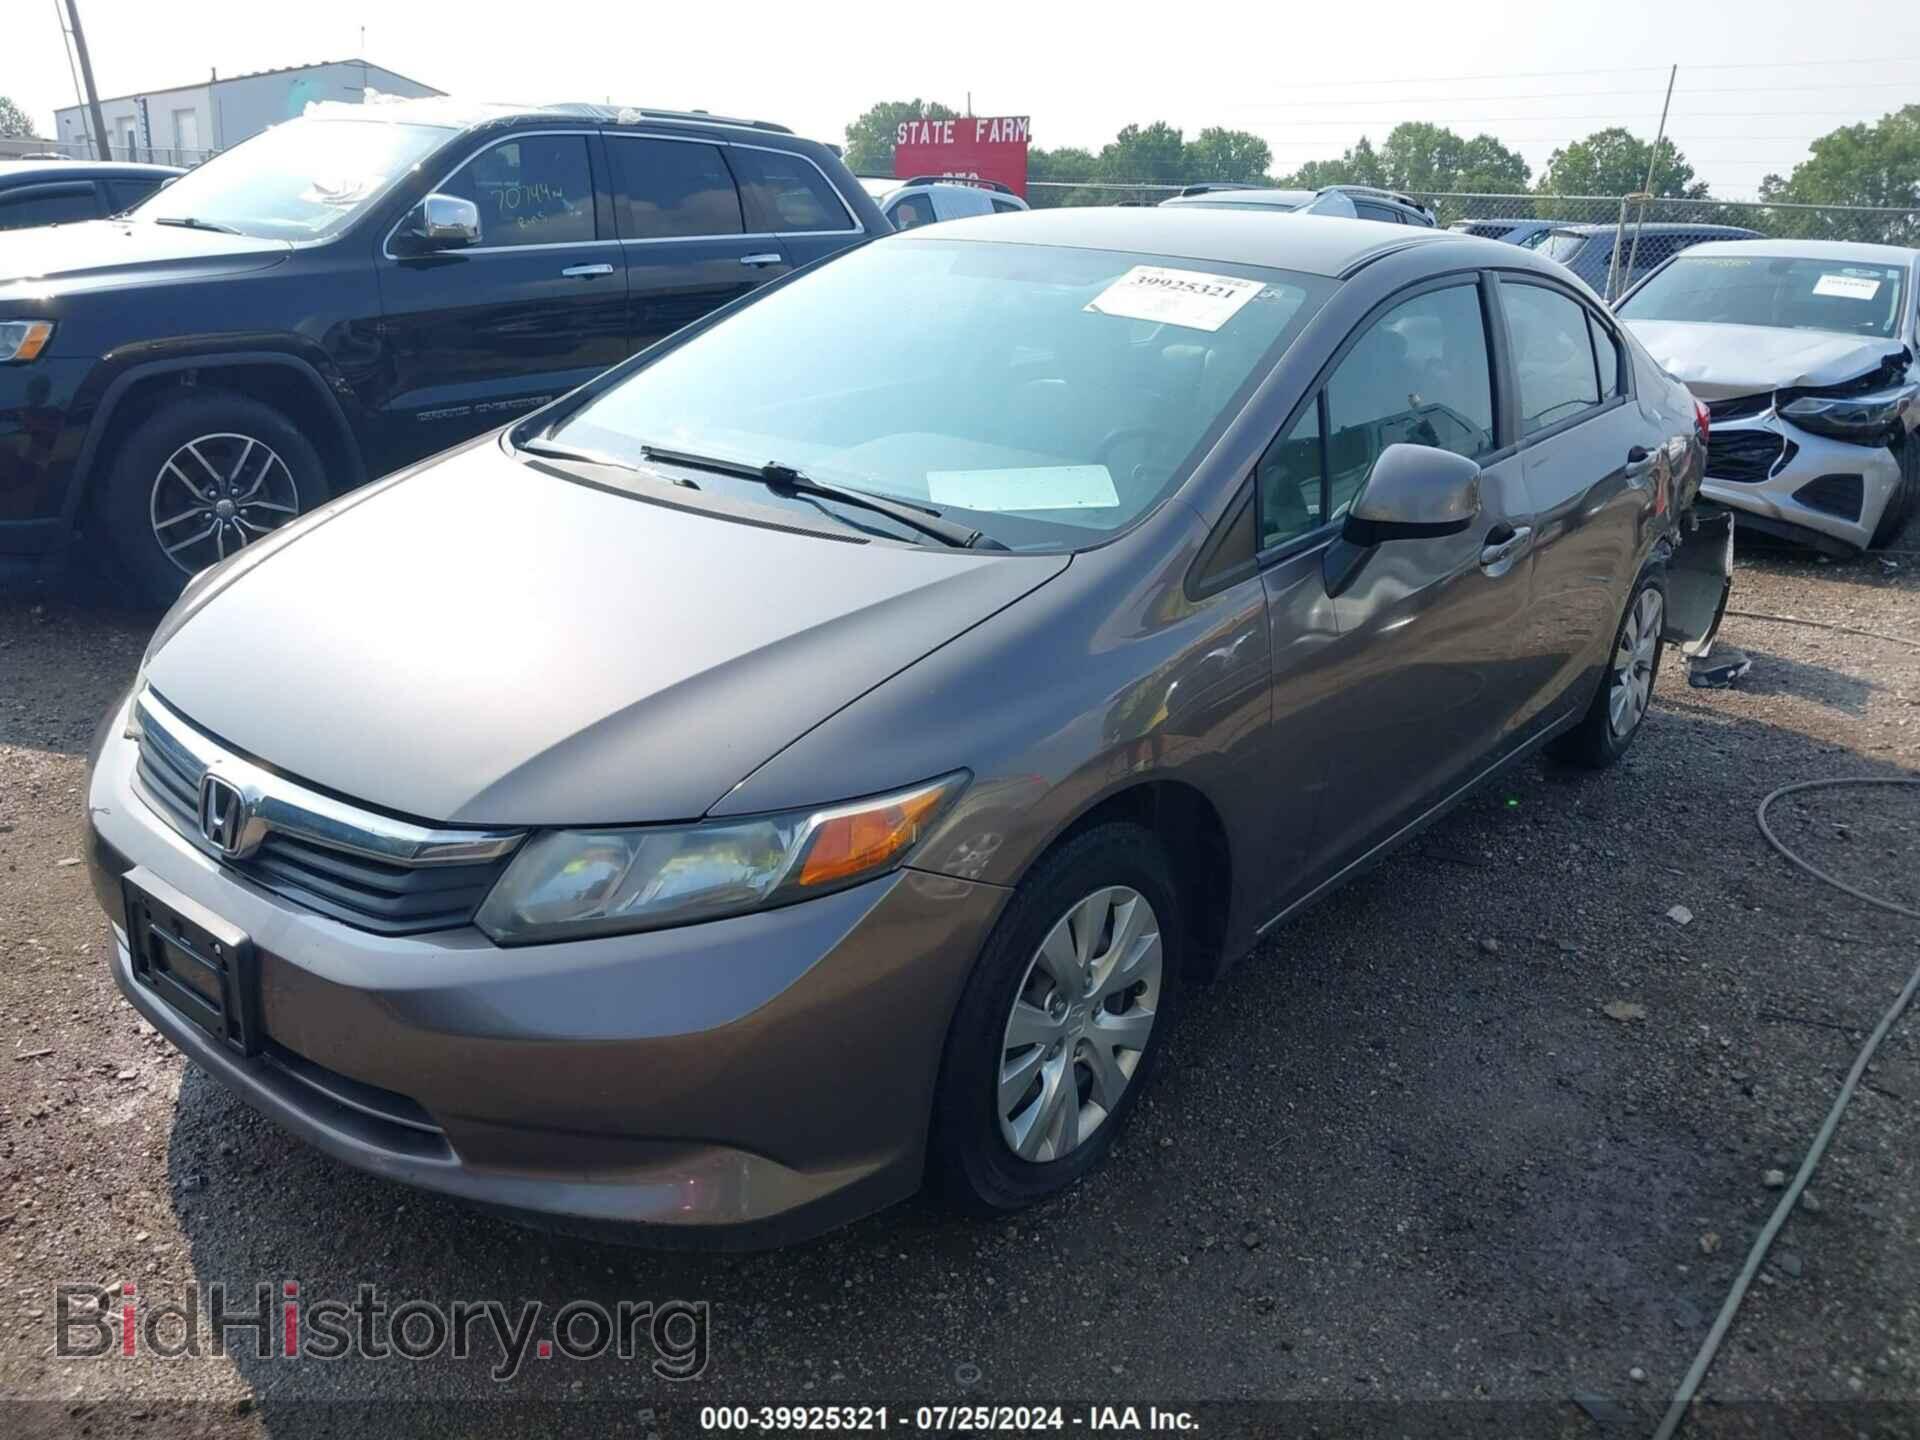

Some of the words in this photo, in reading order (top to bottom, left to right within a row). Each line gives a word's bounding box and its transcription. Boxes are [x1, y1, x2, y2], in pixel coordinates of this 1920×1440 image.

[896, 120, 955, 145] STATE
[975, 117, 1028, 143] FARM
[1131, 275, 1236, 299] 39925321
